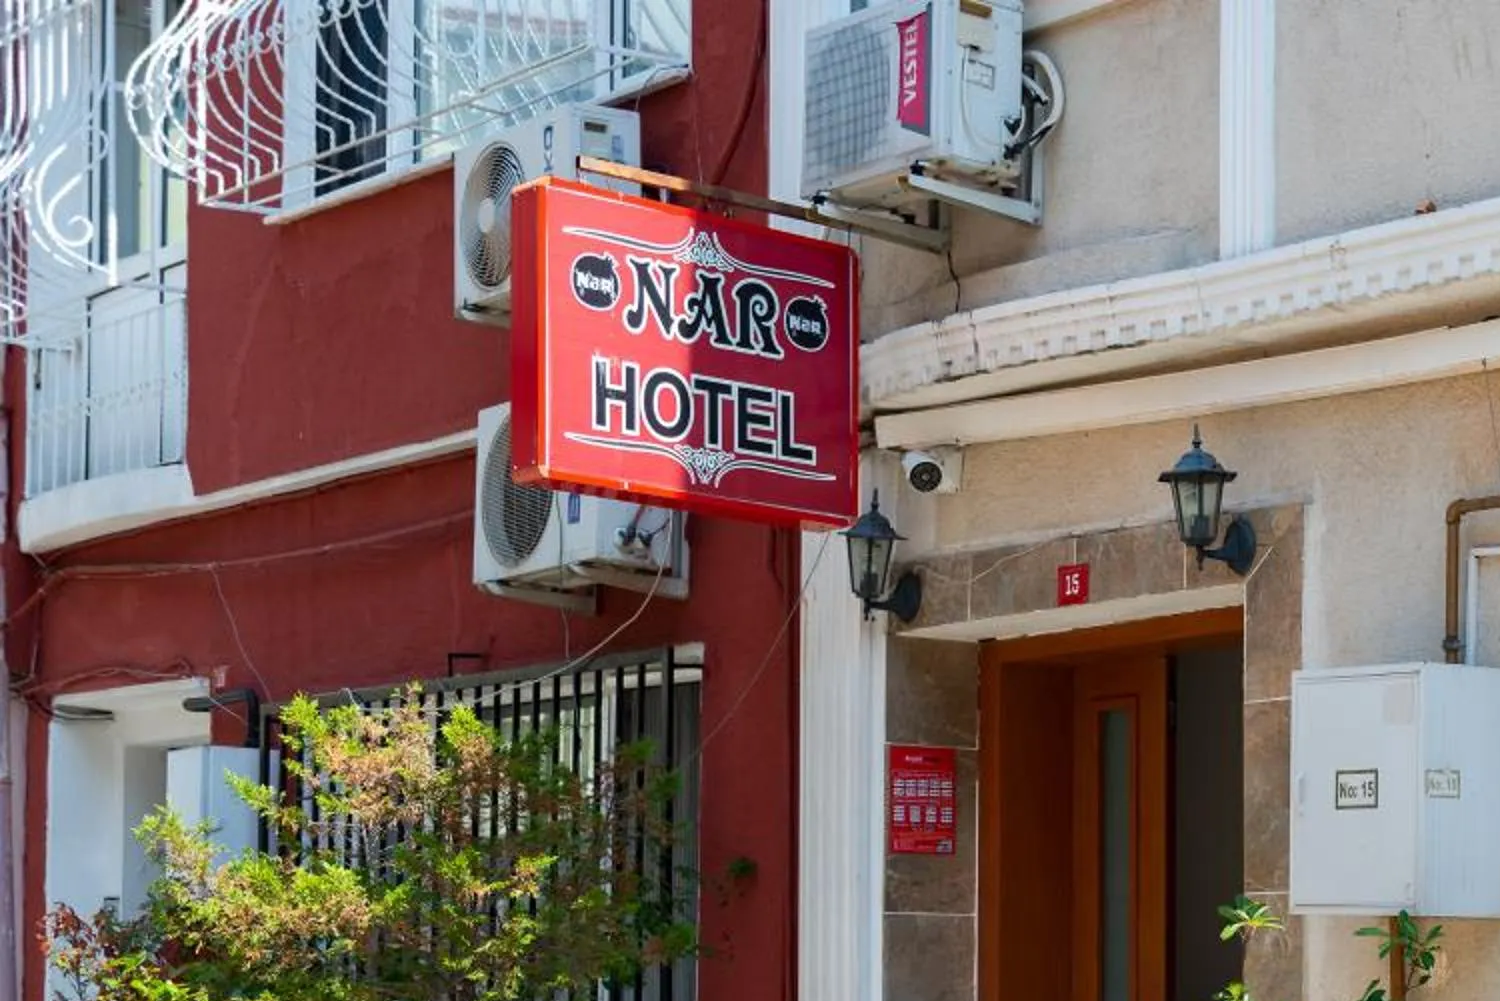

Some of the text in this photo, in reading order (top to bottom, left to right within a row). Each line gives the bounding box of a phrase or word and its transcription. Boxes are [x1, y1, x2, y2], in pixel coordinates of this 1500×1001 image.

[904, 19, 917, 107] VESTEL
[623, 255, 783, 358] NAR
[592, 355, 816, 466] HOTEL
[1065, 573, 1080, 595] 15
[1361, 781, 1376, 798] 15
